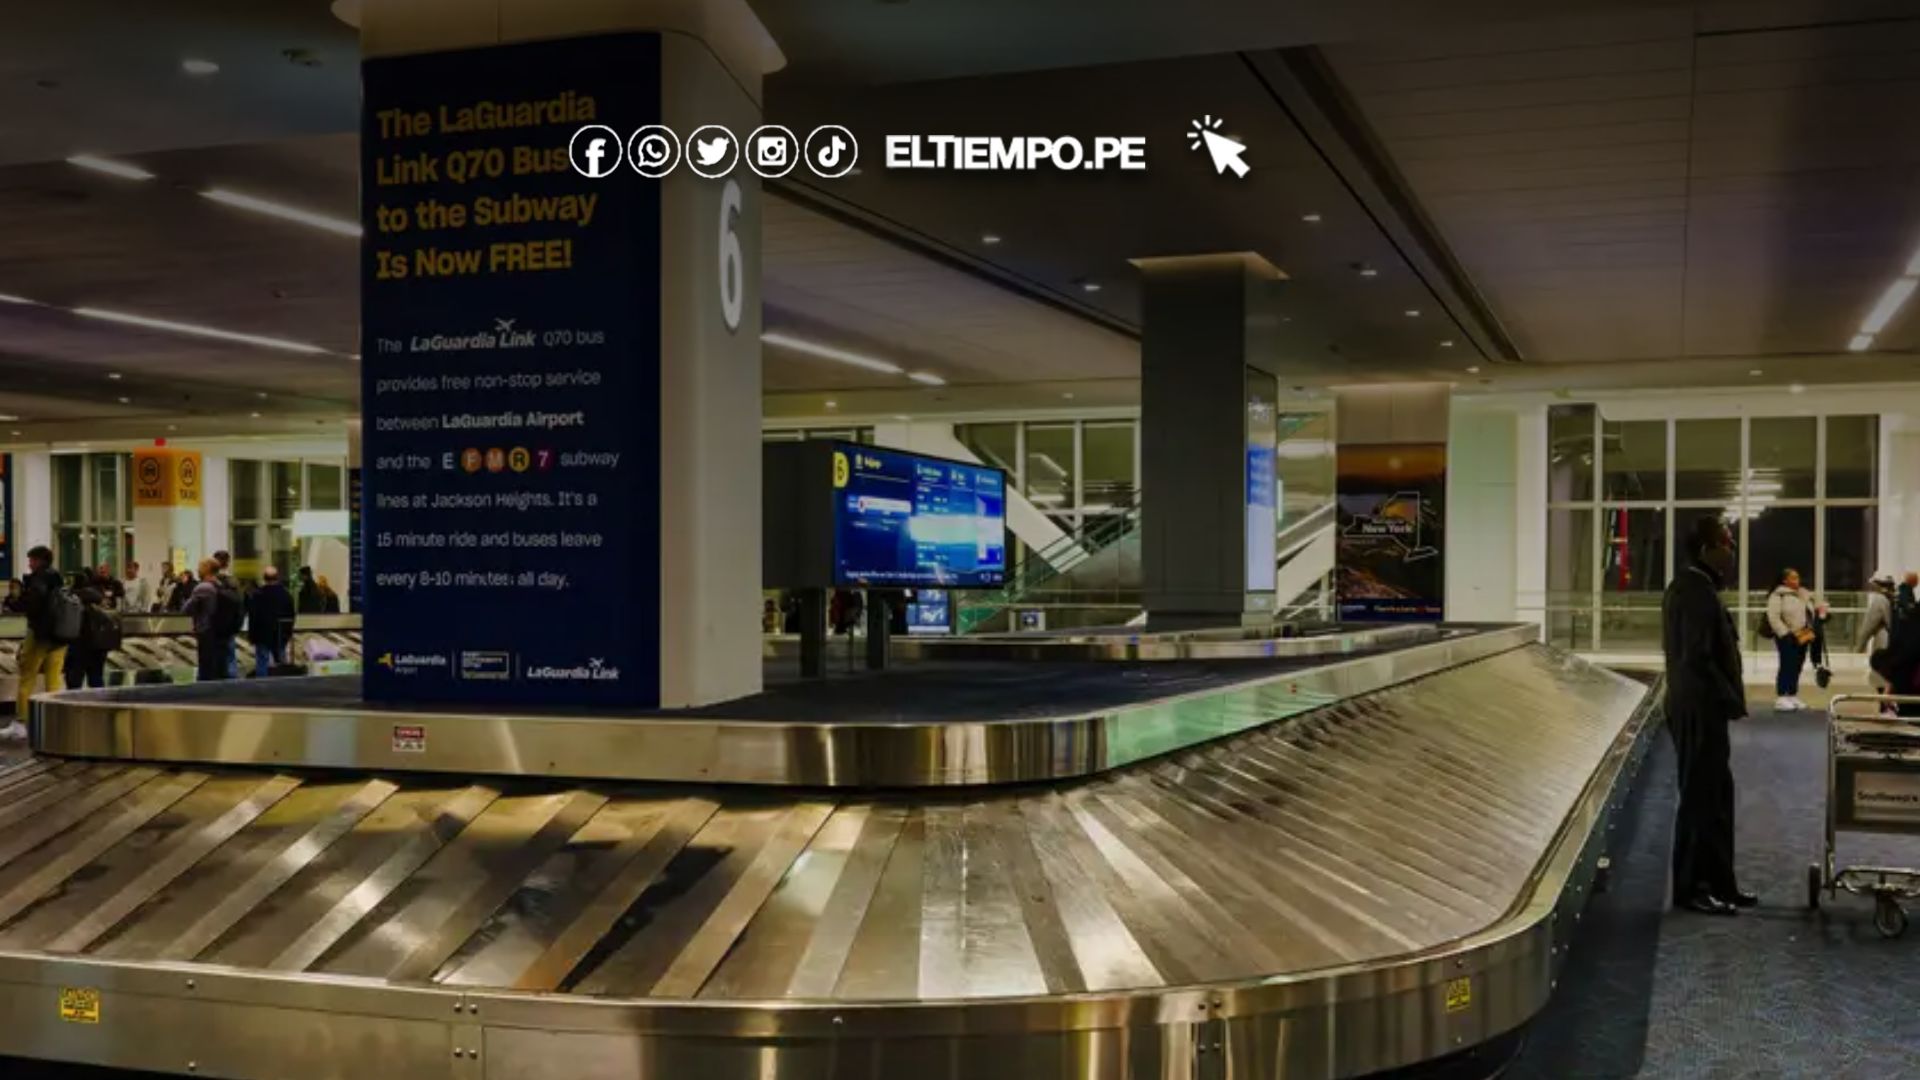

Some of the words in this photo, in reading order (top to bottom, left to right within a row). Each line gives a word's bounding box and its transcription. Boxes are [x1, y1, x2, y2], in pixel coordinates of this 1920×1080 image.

[376, 107, 433, 139] The
[438, 90, 597, 134] LaGuardia
[376, 152, 439, 185] Link
[446, 147, 506, 183] Q70
[512, 145, 570, 175] Bus
[376, 203, 409, 232] to
[415, 198, 467, 230] the
[473, 192, 598, 227] Subway
[376, 249, 409, 279] Is
[415, 246, 482, 276] Now
[488, 238, 573, 272] FREE!
[719, 178, 743, 329] 6
[377, 338, 402, 353] The
[410, 333, 496, 352] LaGuardia
[499, 330, 536, 347] Link
[543, 330, 572, 346] Q70
[576, 329, 605, 344] bus
[376, 375, 438, 394] provides
[441, 373, 471, 390] free
[474, 370, 542, 389] non-stop
[545, 368, 601, 385] service
[376, 415, 439, 431] between
[442, 412, 523, 429] LaGuardia
[526, 410, 585, 429] Airport
[376, 453, 404, 469] and
[407, 453, 431, 468] the
[442, 453, 454, 469] E
[538, 452, 549, 467] 7
[560, 450, 620, 468] subway
[139, 488, 162, 499] TAXI
[376, 492, 409, 508] lines
[412, 493, 428, 508] at
[431, 490, 492, 508] Jackson
[495, 490, 554, 511] Heights.
[558, 490, 583, 507] It's
[586, 493, 598, 507] a
[377, 531, 393, 548] 15
[395, 530, 446, 548] minute
[449, 531, 477, 548] ride
[480, 531, 509, 548] and
[512, 530, 557, 548] buses
[560, 530, 602, 548] leave
[1388, 523, 1413, 533] York
[376, 572, 417, 592] every
[418, 570, 451, 588] 8-10
[516, 570, 534, 587] all
[537, 569, 570, 590] day.
[526, 666, 590, 679] LaGuardia
[592, 665, 620, 680] Link
